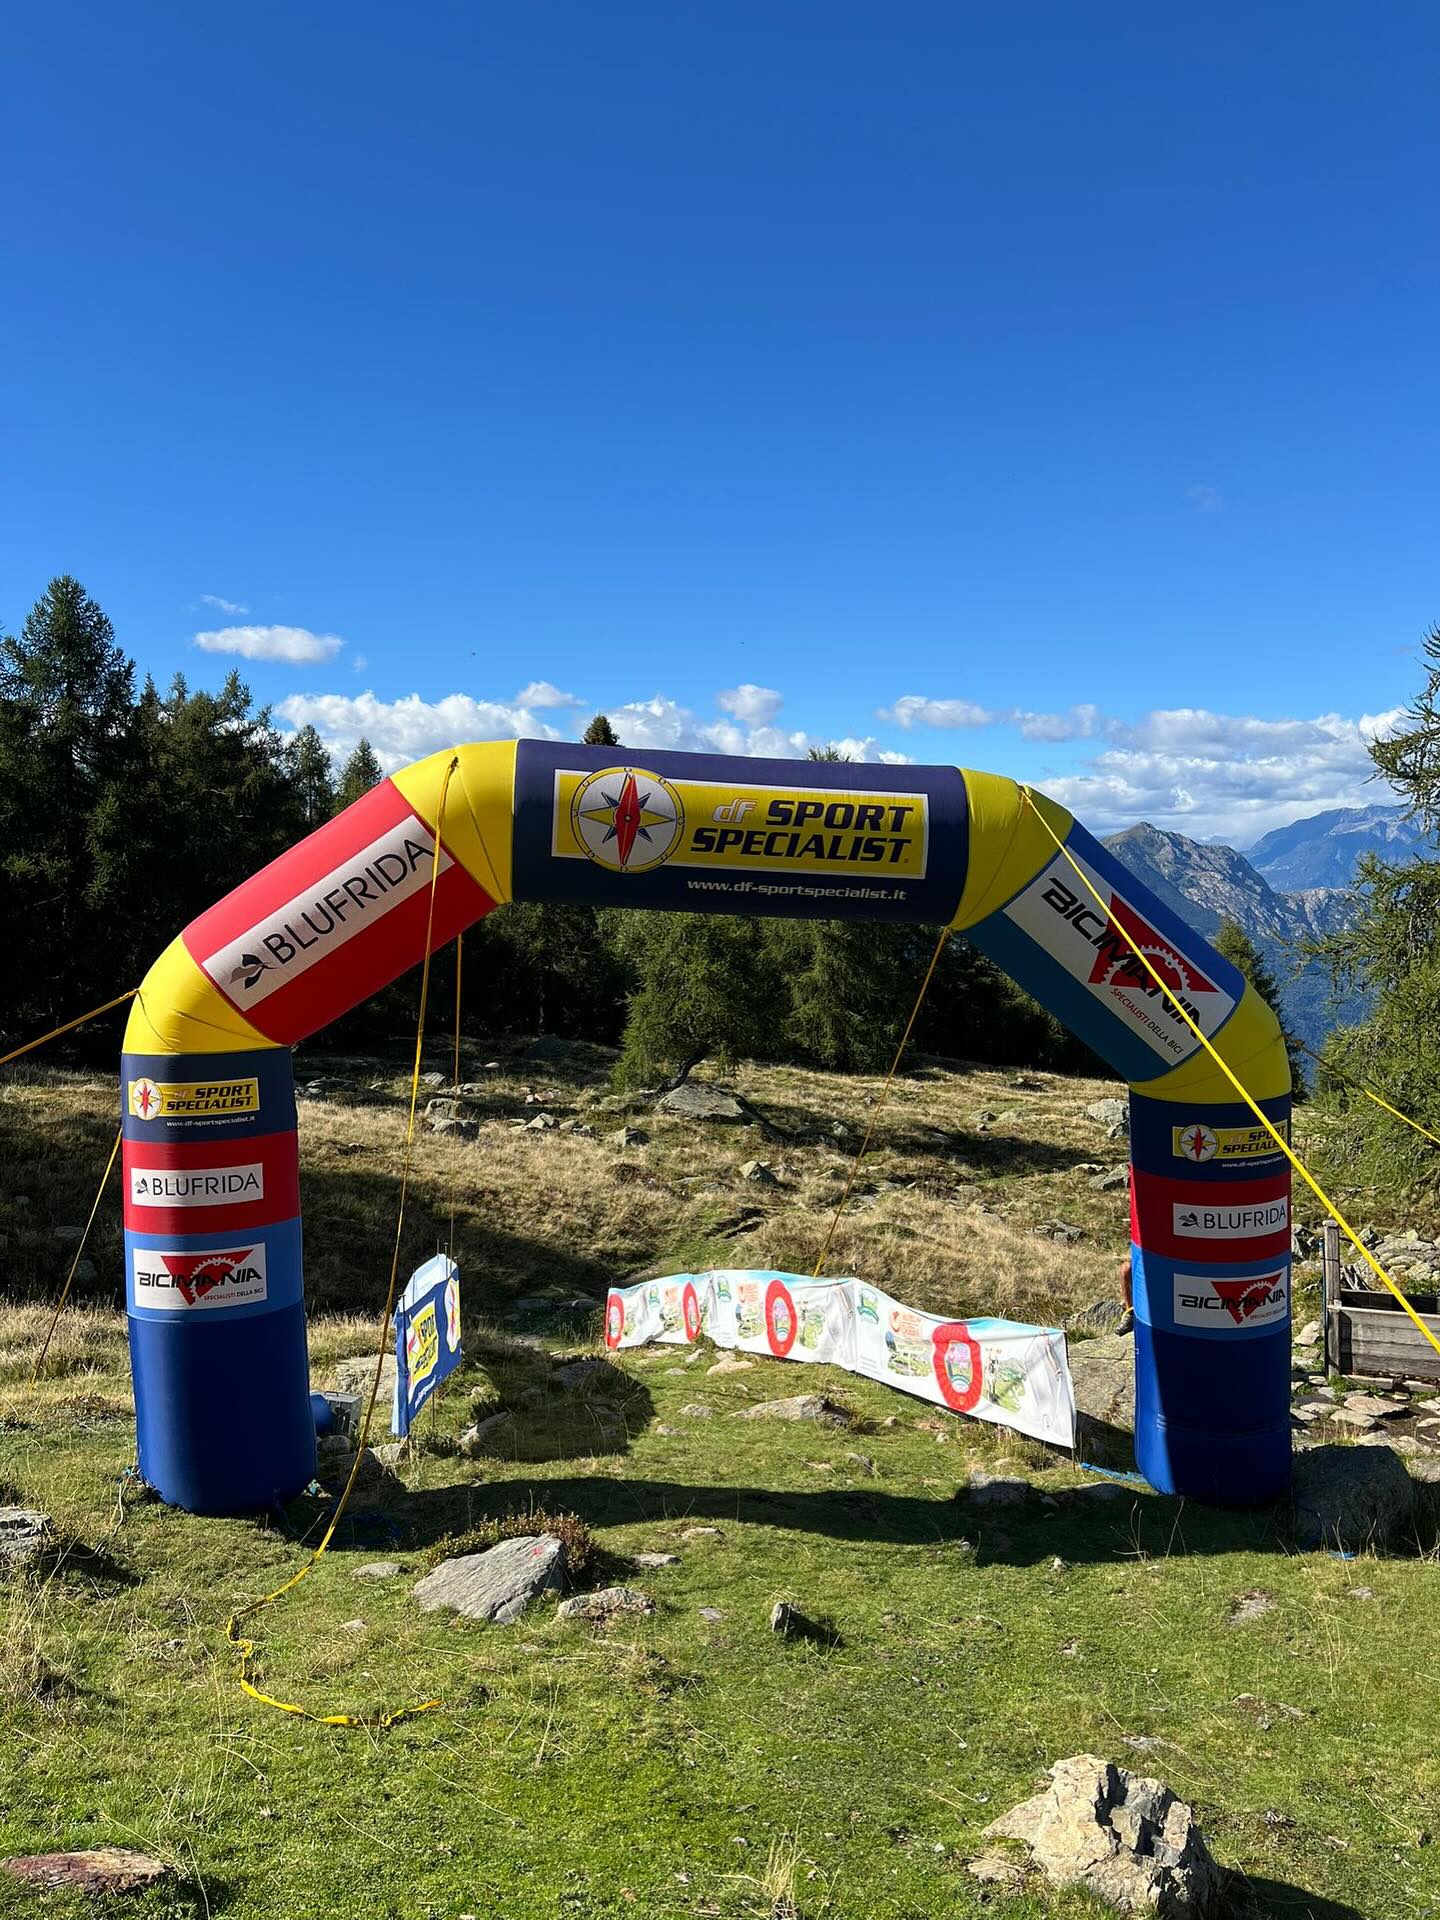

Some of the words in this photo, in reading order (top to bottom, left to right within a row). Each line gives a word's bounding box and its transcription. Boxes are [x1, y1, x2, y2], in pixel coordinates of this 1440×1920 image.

[712, 797, 759, 824] df
[765, 799, 913, 832] SPORT
[690, 828, 913, 864] SPECIALIST
[262, 838, 435, 965] BLUFRIDA
[687, 880, 907, 900] www.df-sportspecialist.it
[1041, 877, 1201, 1041] BICIMANIA
[1111, 988, 1149, 1025] SPECIALISTI
[1147, 1020, 1170, 1042] DELLA
[1167, 1040, 1184, 1055] BICI
[194, 1083, 253, 1099] SPORT
[166, 1096, 253, 1111] SPECIALIST
[166, 1115, 255, 1127] www.df-sportspecialist.it
[153, 1172, 260, 1196] BLUFRIDA
[1203, 1206, 1287, 1230] BLUFRIDA
[137, 1267, 263, 1289] BICIMANIA
[1177, 1288, 1287, 1310] BICIMANIA
